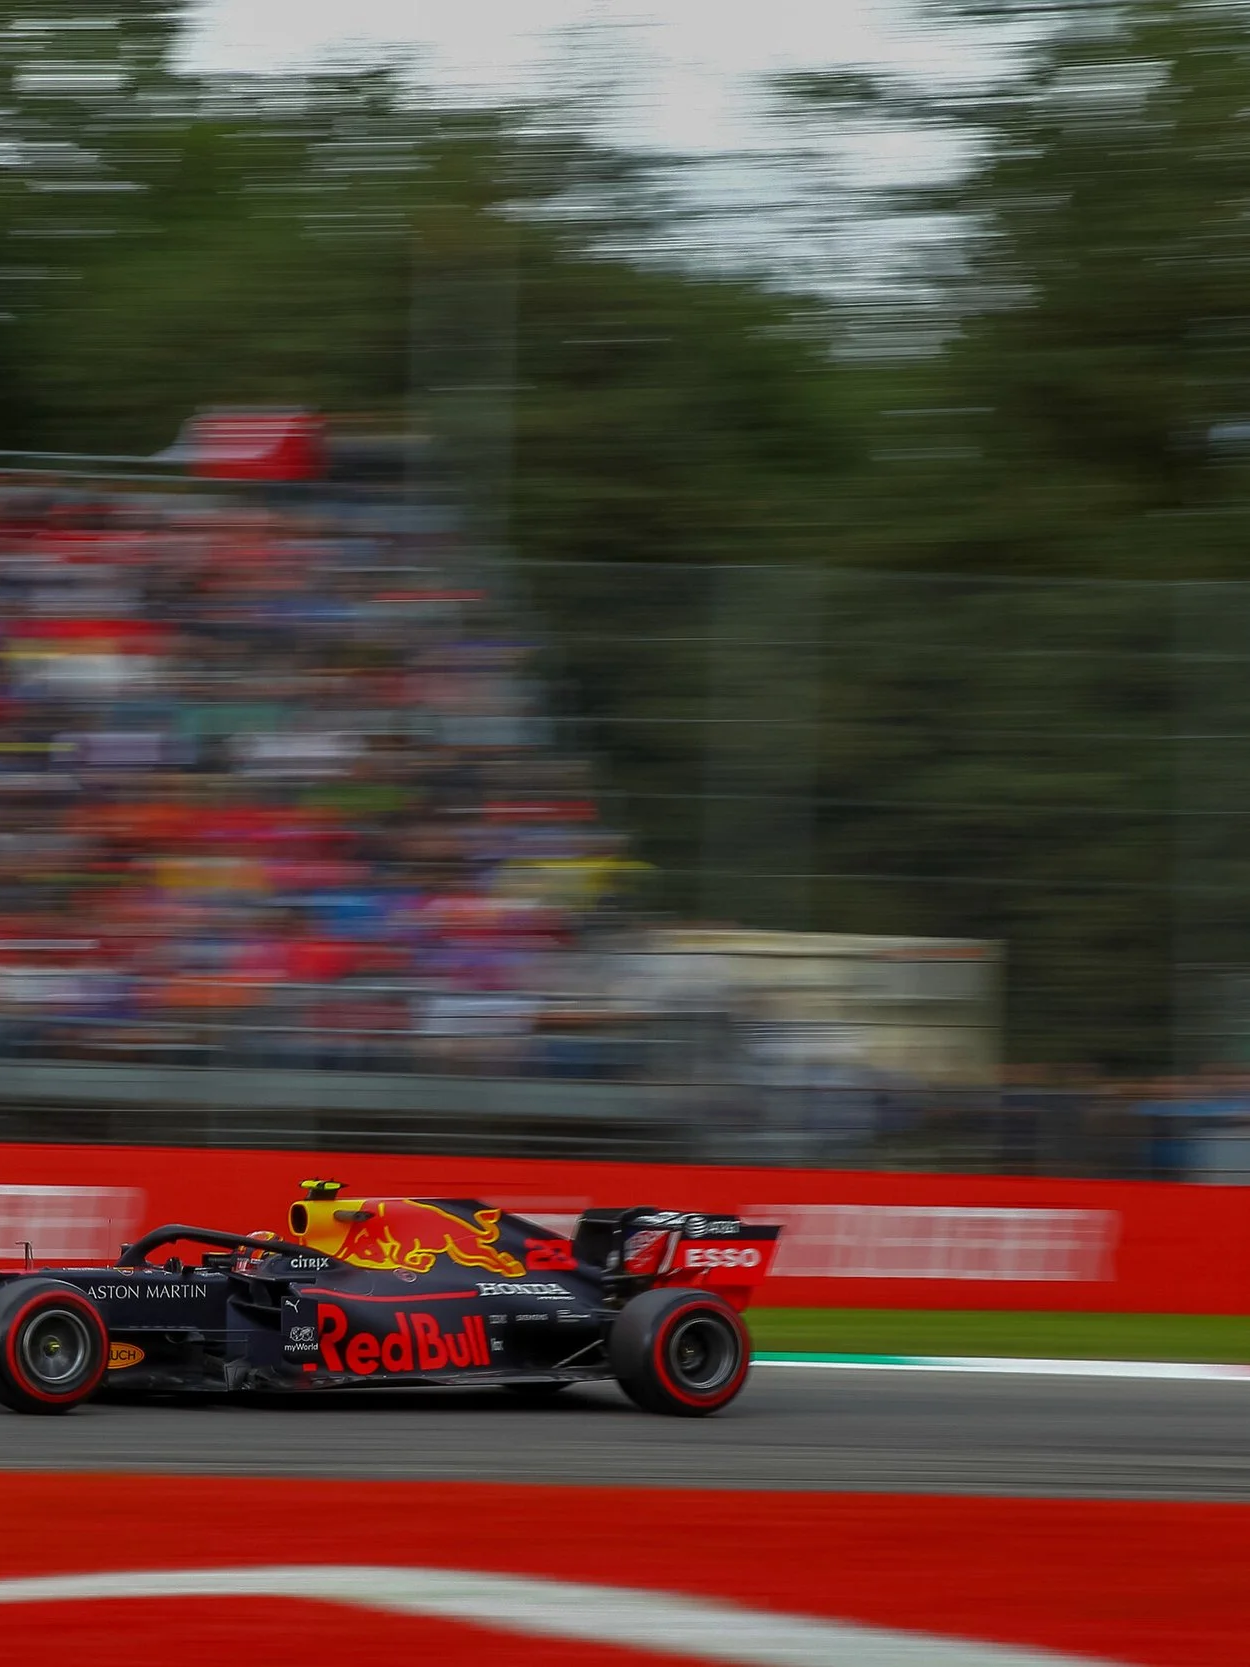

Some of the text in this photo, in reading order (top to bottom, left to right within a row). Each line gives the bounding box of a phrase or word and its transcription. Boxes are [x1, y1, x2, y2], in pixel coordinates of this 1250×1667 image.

[685, 1248, 762, 1268] ESSO
[87, 1284, 207, 1299] ASTON MARTIN
[476, 1283, 572, 1297] HONDA
[284, 1343, 319, 1352] myWorld
[110, 1350, 136, 1361] UCH
